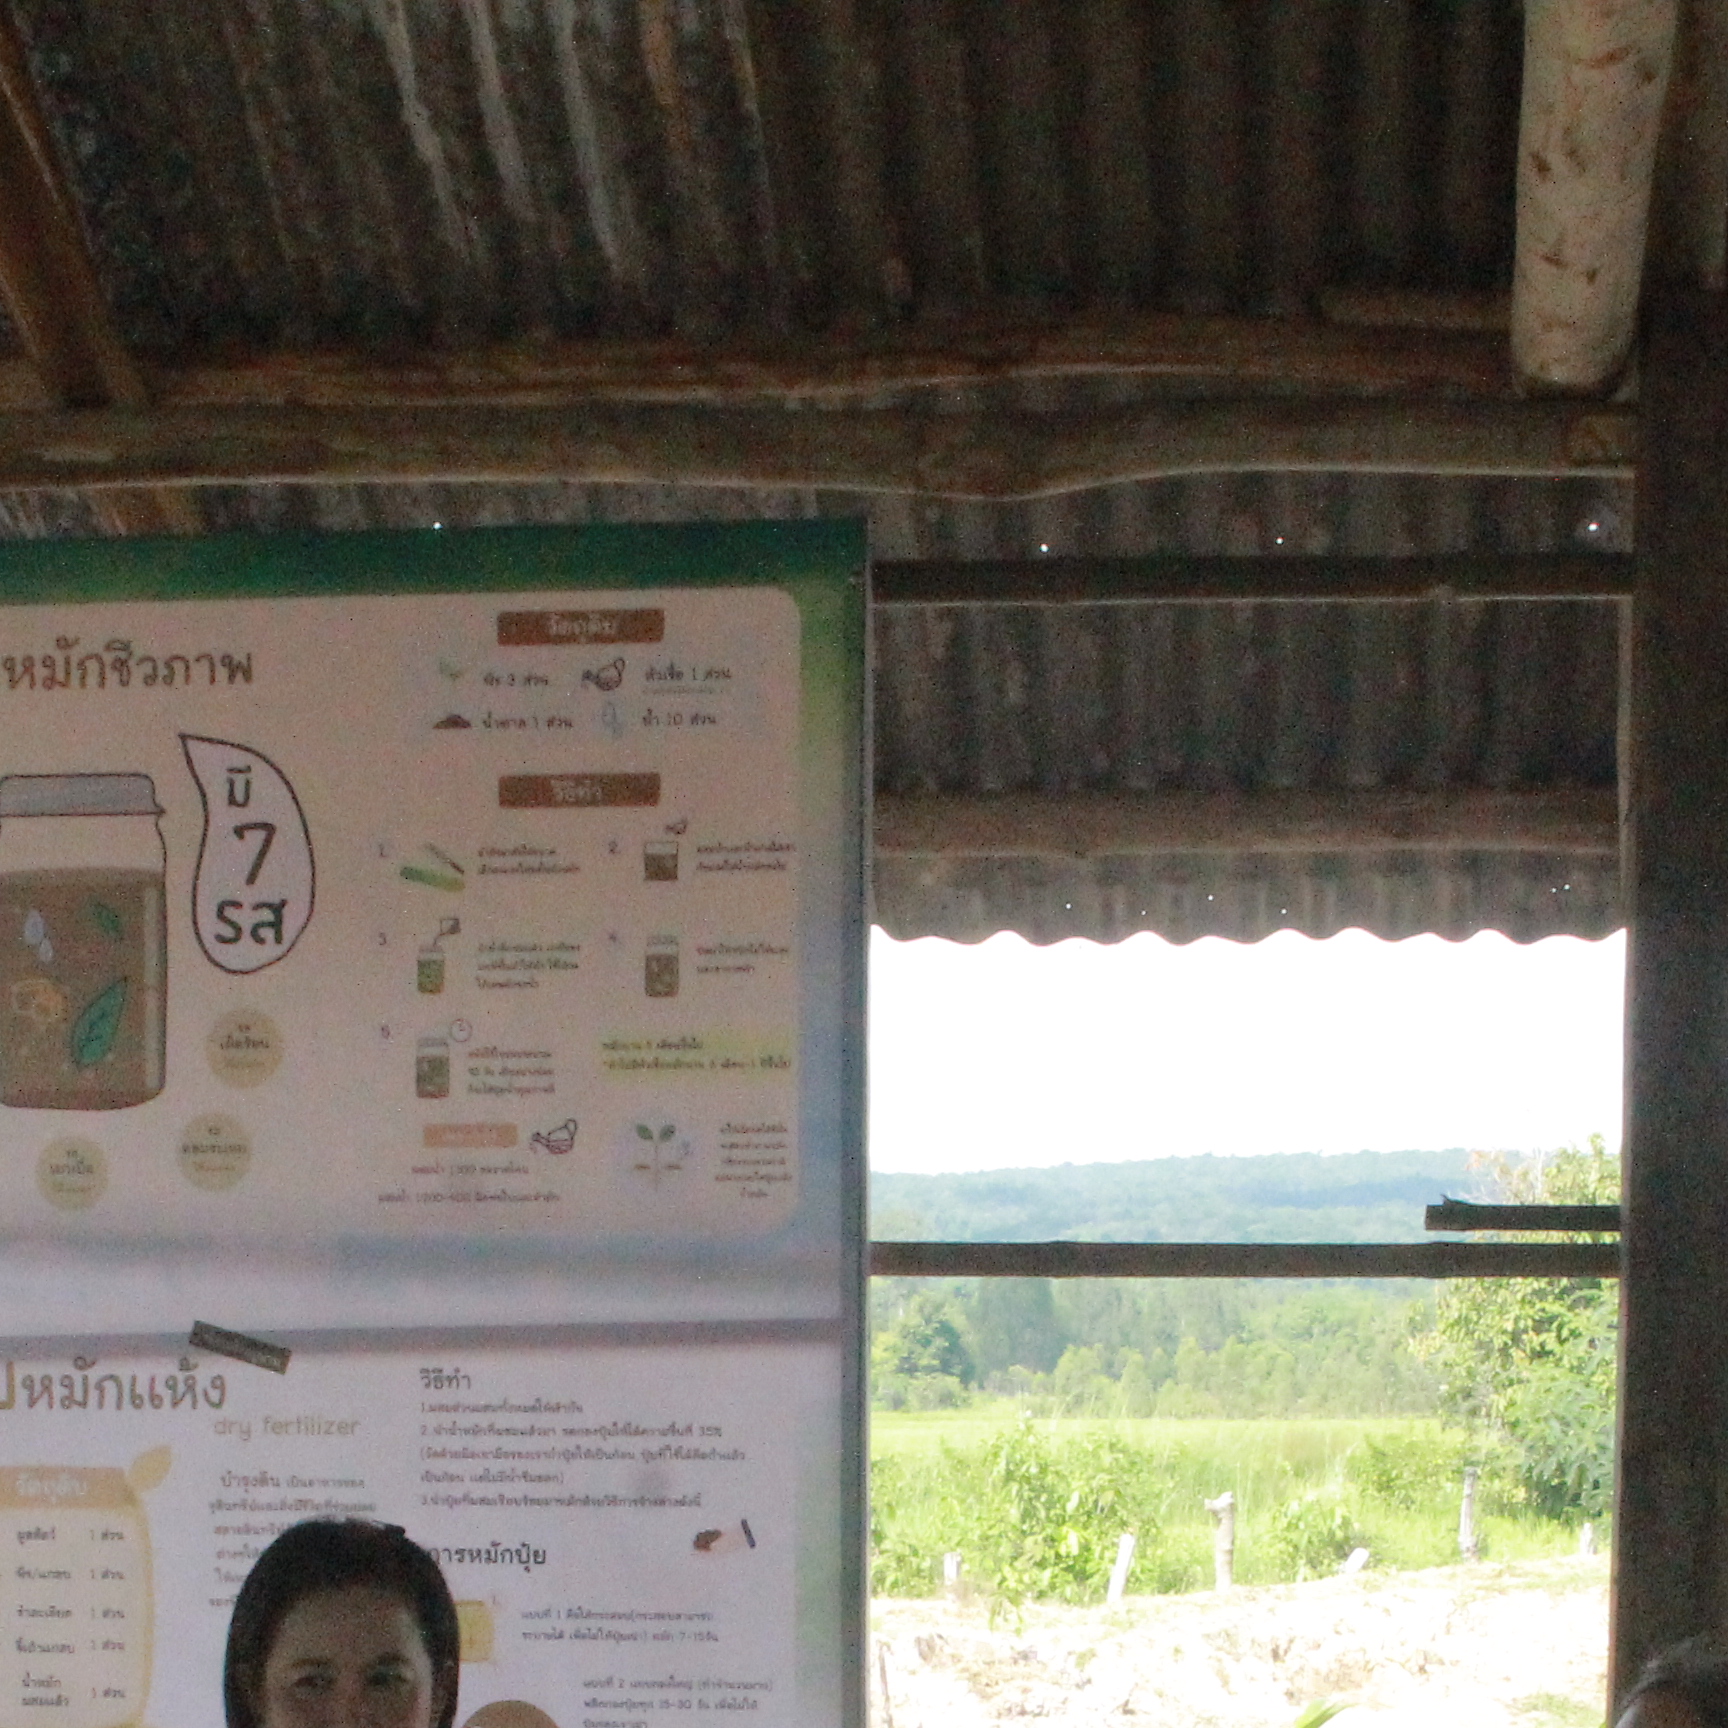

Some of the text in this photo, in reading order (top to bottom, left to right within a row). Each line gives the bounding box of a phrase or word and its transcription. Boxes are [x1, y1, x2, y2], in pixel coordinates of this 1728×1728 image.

[226, 766, 254, 809] มี
[233, 823, 278, 886] 7
[214, 897, 288, 948] รส
[418, 1367, 473, 1391] วิธีทำ
[213, 1414, 361, 1441] dry fertilizer
